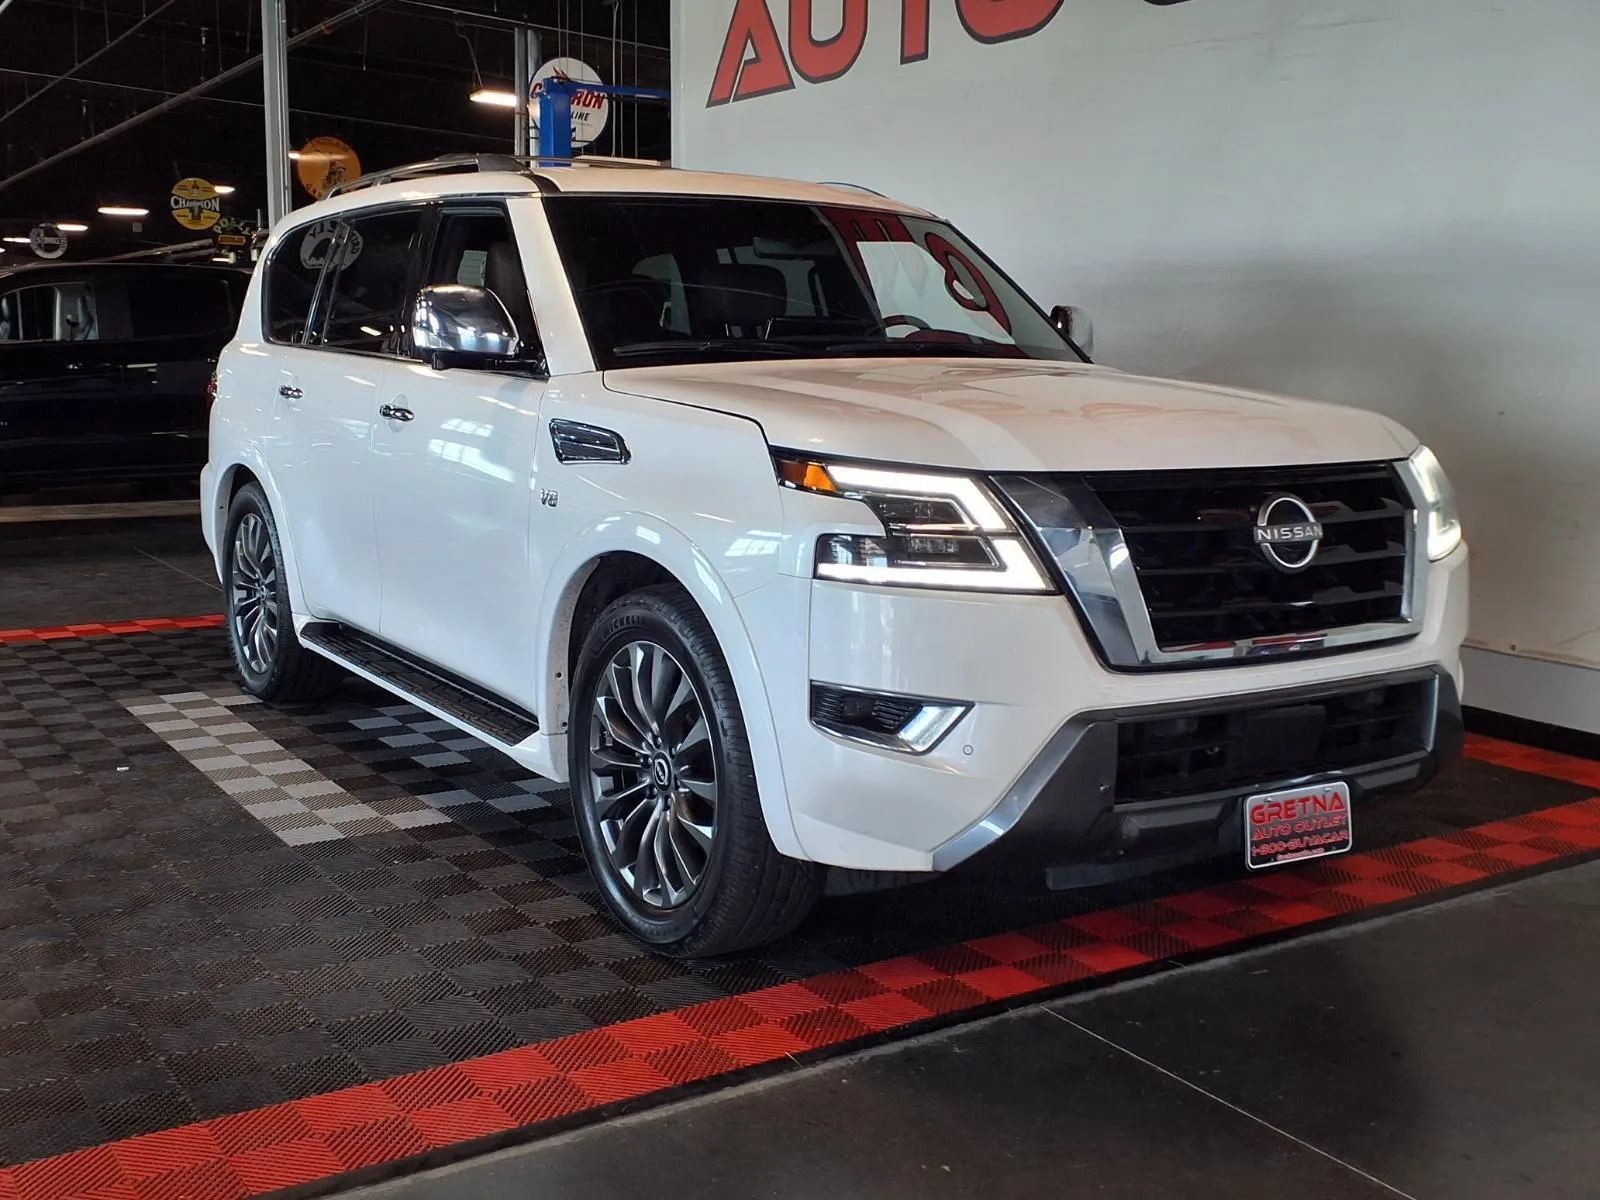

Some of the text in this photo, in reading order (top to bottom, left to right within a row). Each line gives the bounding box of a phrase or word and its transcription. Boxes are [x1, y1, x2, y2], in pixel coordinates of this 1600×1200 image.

[1257, 526, 1322, 540] NISSAN
[1251, 791, 1345, 825] GRETNA
[1254, 813, 1347, 840] AUTO OUTLET
